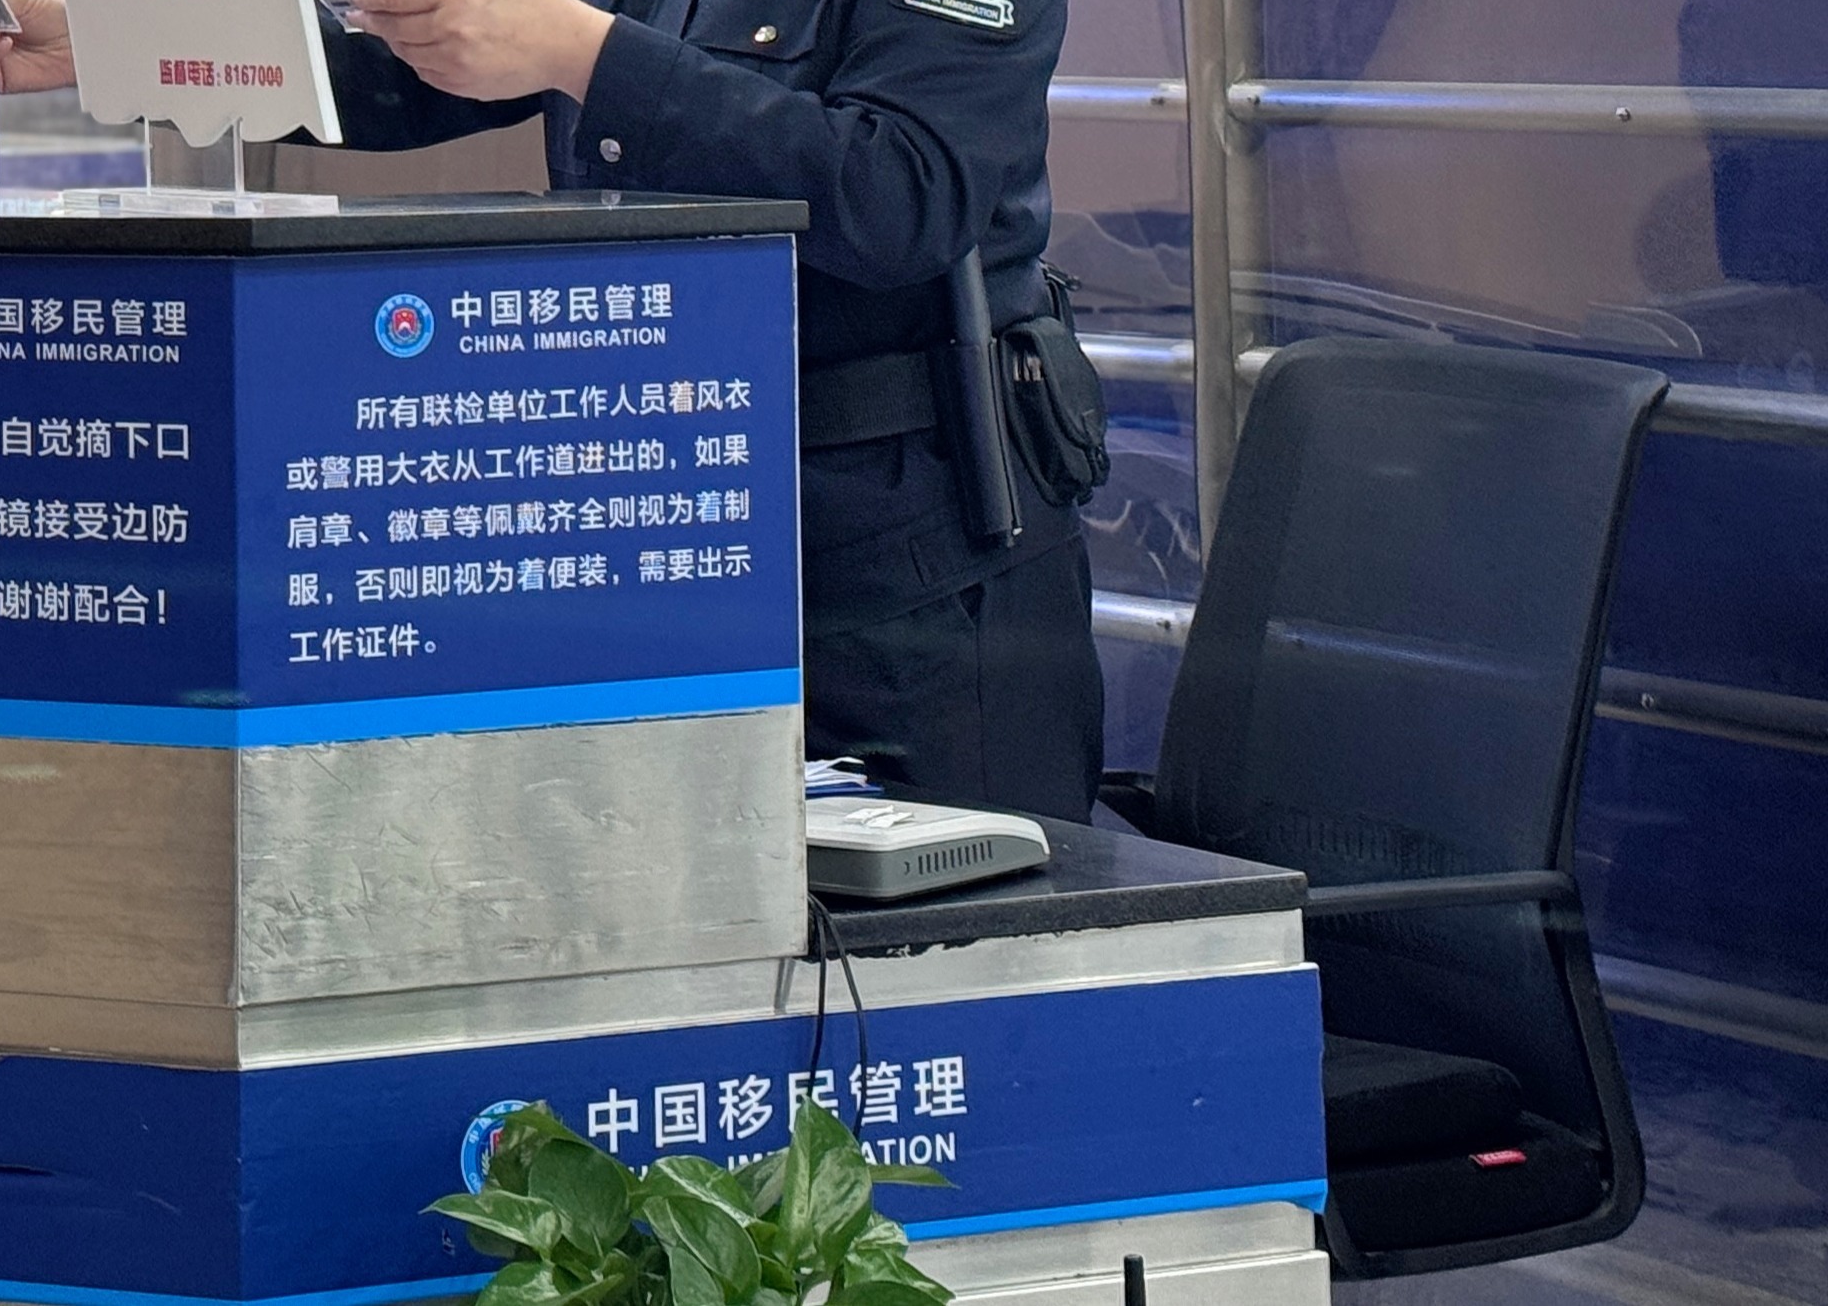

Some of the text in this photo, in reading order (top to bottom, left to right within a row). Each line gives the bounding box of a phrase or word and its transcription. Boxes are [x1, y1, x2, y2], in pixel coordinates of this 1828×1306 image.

[451, 283, 673, 329] 中国移民管理
[36, 343, 181, 363] IMMIGRATION
[459, 327, 667, 355] CHINA IMMIGRATION
[356, 378, 752, 430] 所有联检单位工作人员着风衣
[285, 433, 751, 492] 或警用大衣从工作道进出的，如果
[286, 488, 751, 551] 肩章、徽章等佩戴齐全则视为着制
[287, 544, 753, 607] 服，否则即视为着便装，需要出示
[288, 623, 438, 664] 工作证件。
[587, 1055, 969, 1154] 中国移民管理
